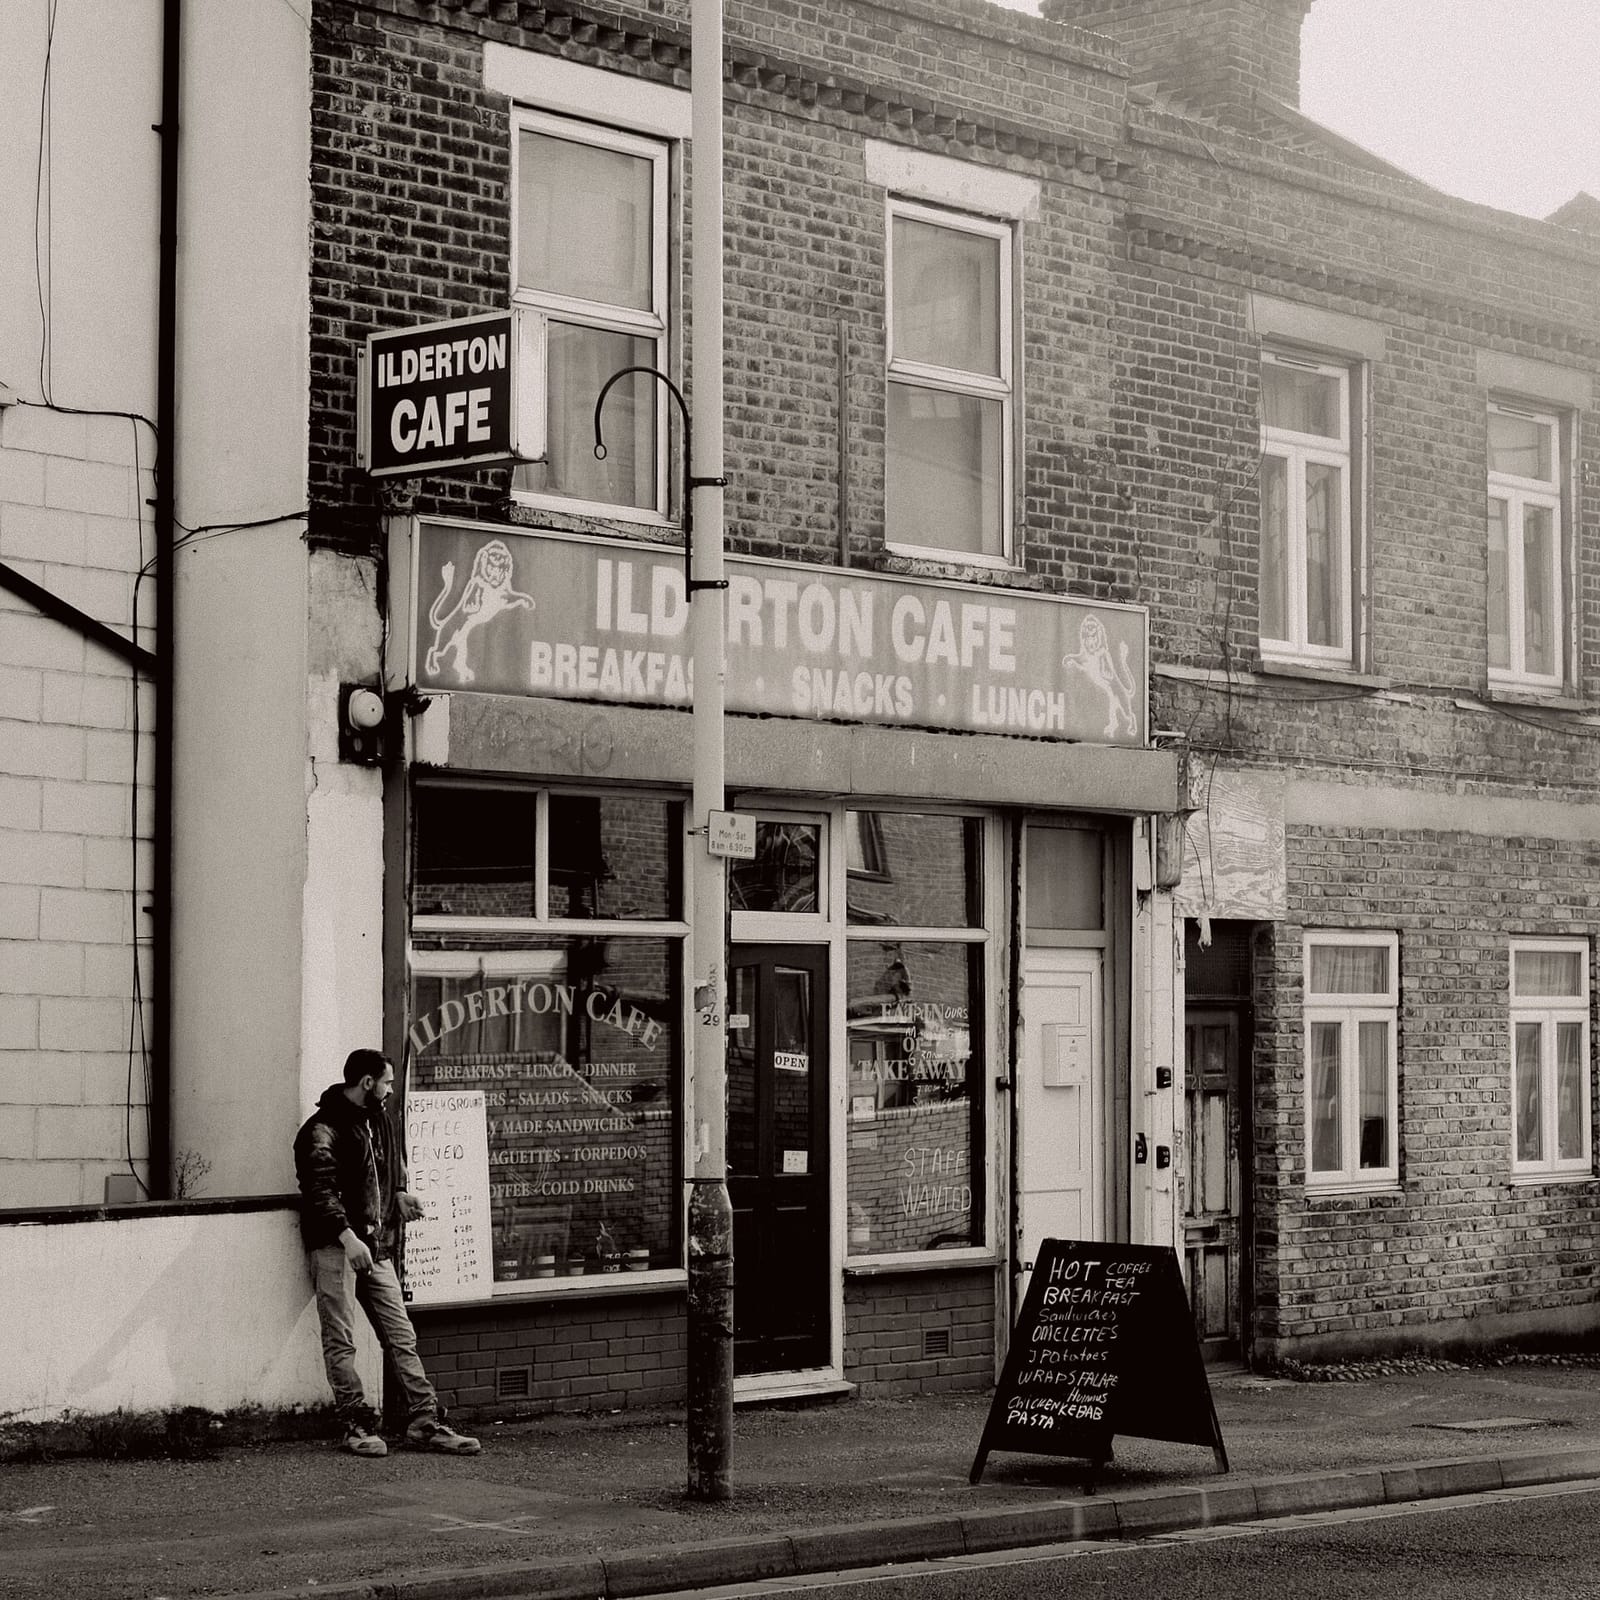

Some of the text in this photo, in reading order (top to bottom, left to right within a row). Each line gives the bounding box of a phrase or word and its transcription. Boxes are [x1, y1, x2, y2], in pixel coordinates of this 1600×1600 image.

[377, 333, 506, 388] ILDERTON
[390, 387, 492, 453] CAFE
[596, 558, 1016, 672] ILDRTON CAFE
[530, 640, 1065, 730] BREAKFA SNACKS LUNCH
[408, 983, 663, 1055] ILDERTON CAFE
[703, 1013, 720, 1026] 29
[434, 1062, 637, 1080] BREAKFAST LUNCH DINNER
[775, 1056, 806, 1069] OPEN
[858, 1059, 966, 1081] TAKE AWAY
[518, 1091, 569, 1106] SALADS
[581, 1090, 632, 1105] SNACKS
[502, 1119, 543, 1135] MADE
[545, 1116, 635, 1133] SANDWICHES
[411, 1144, 464, 1164] ERVED
[488, 1145, 647, 1165] AGUETTES TORPEDO'S
[904, 1147, 966, 1178] STAFF
[412, 1167, 456, 1191] ERE
[489, 1177, 635, 1199] OFFEE COLD DRINKS
[899, 1184, 972, 1217] WANTED
[1050, 1257, 1153, 1283] HOT COFFEE
[1105, 1276, 1135, 1289] TEA
[1043, 1286, 1141, 1306] BREAKFAST
[1018, 1369, 1078, 1385] WRAPS
[1007, 1410, 1054, 1429] PASTA
[1058, 1403, 1103, 1420] KEBAB
